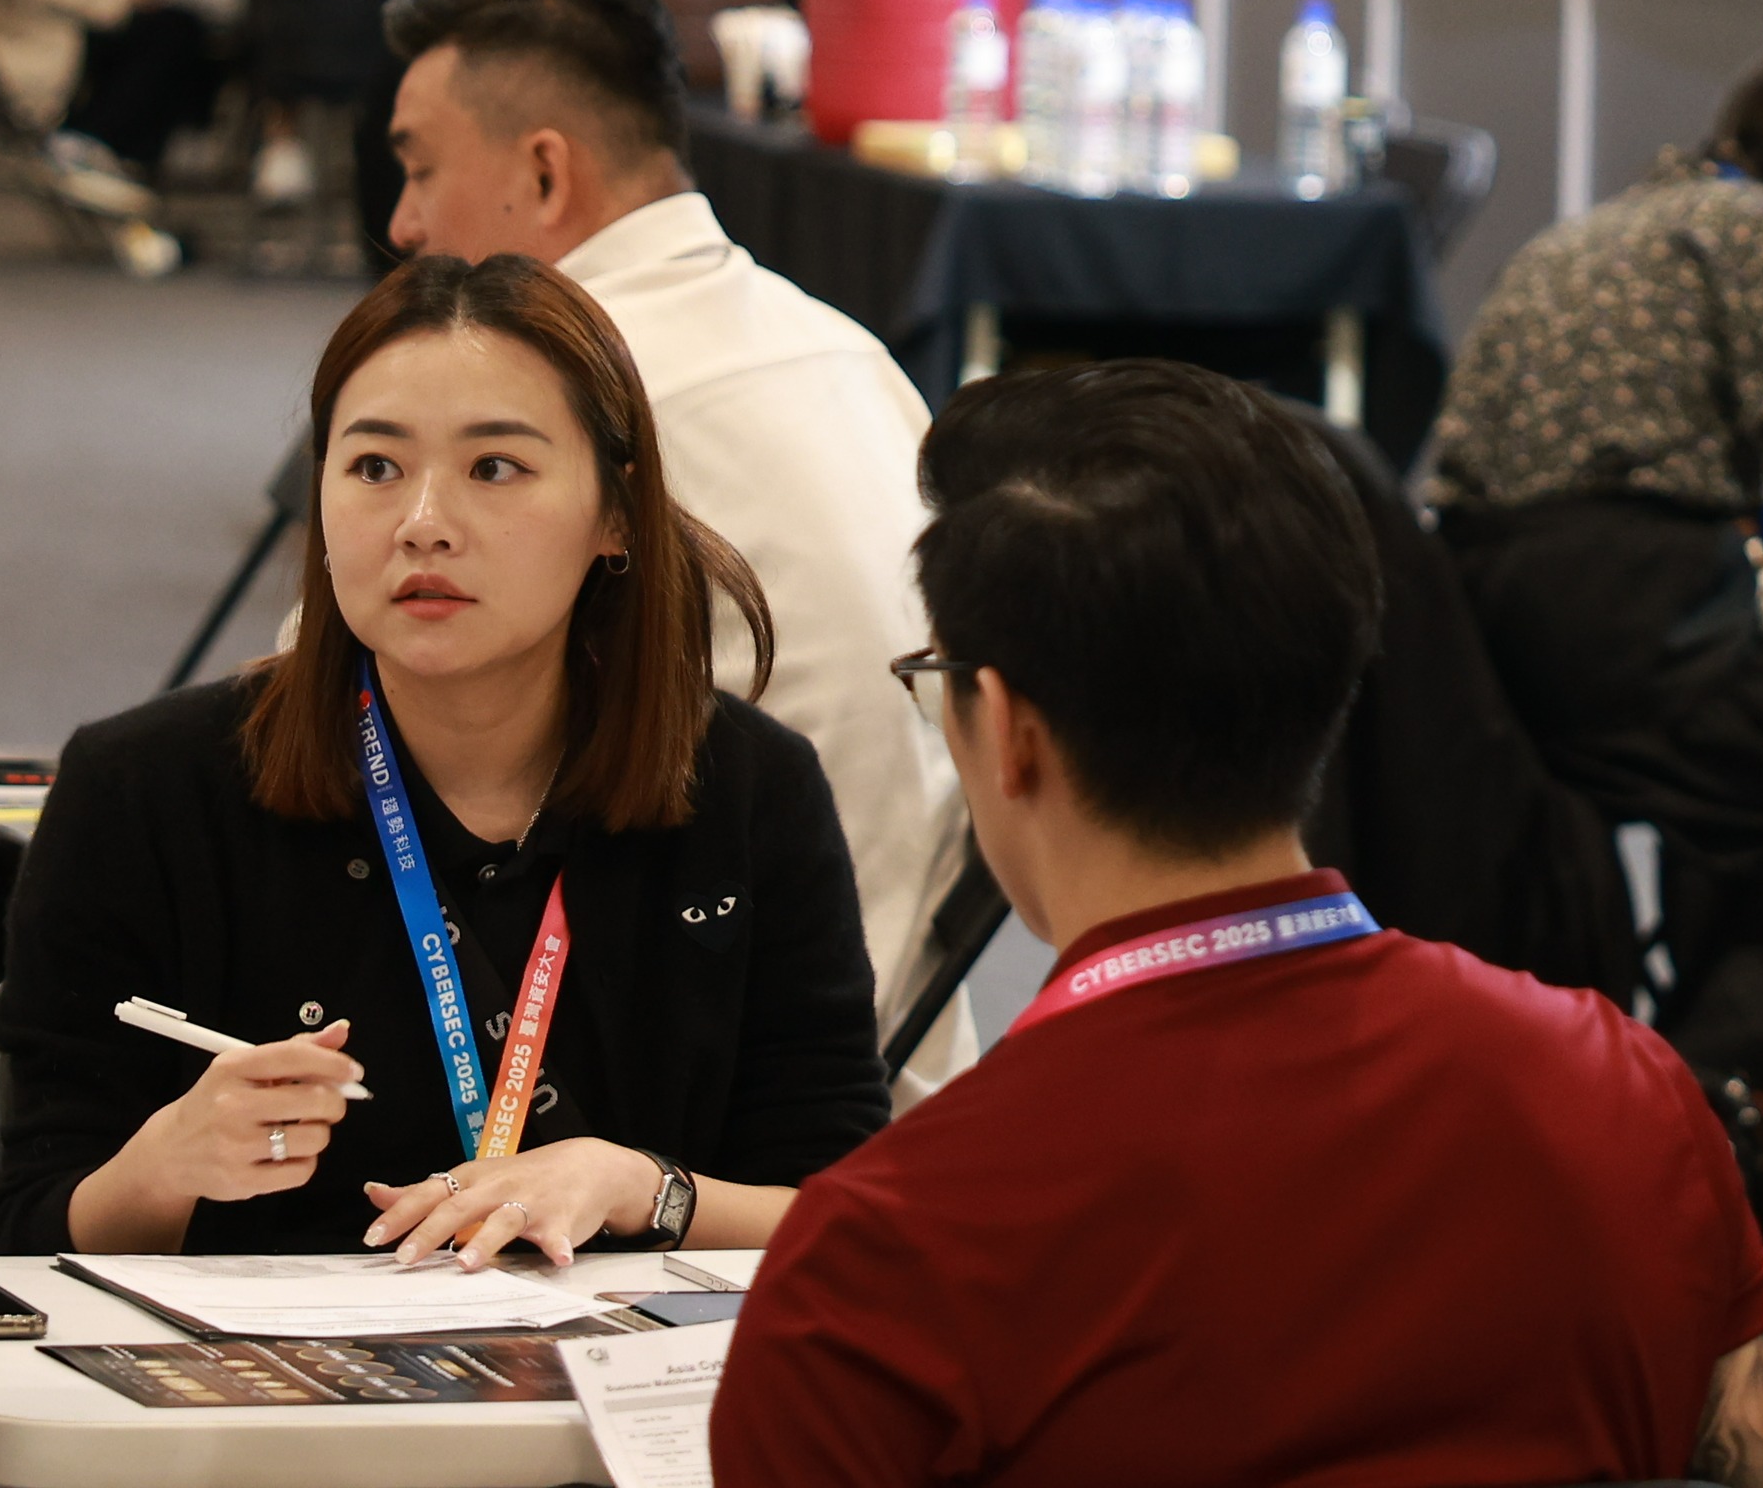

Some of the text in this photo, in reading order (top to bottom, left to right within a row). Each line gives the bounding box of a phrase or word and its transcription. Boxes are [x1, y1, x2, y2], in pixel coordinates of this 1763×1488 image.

[358, 712, 390, 786] TREND
[380, 796, 416, 873] 趨勢科技
[518, 933, 562, 1039] 臺灣資安大會
[1068, 933, 1208, 996] CYBERSEC
[1210, 918, 1272, 955] 2025
[421, 932, 466, 1049] CYBERSEC
[452, 1051, 479, 1105] 2025
[505, 1043, 534, 1093] 2025
